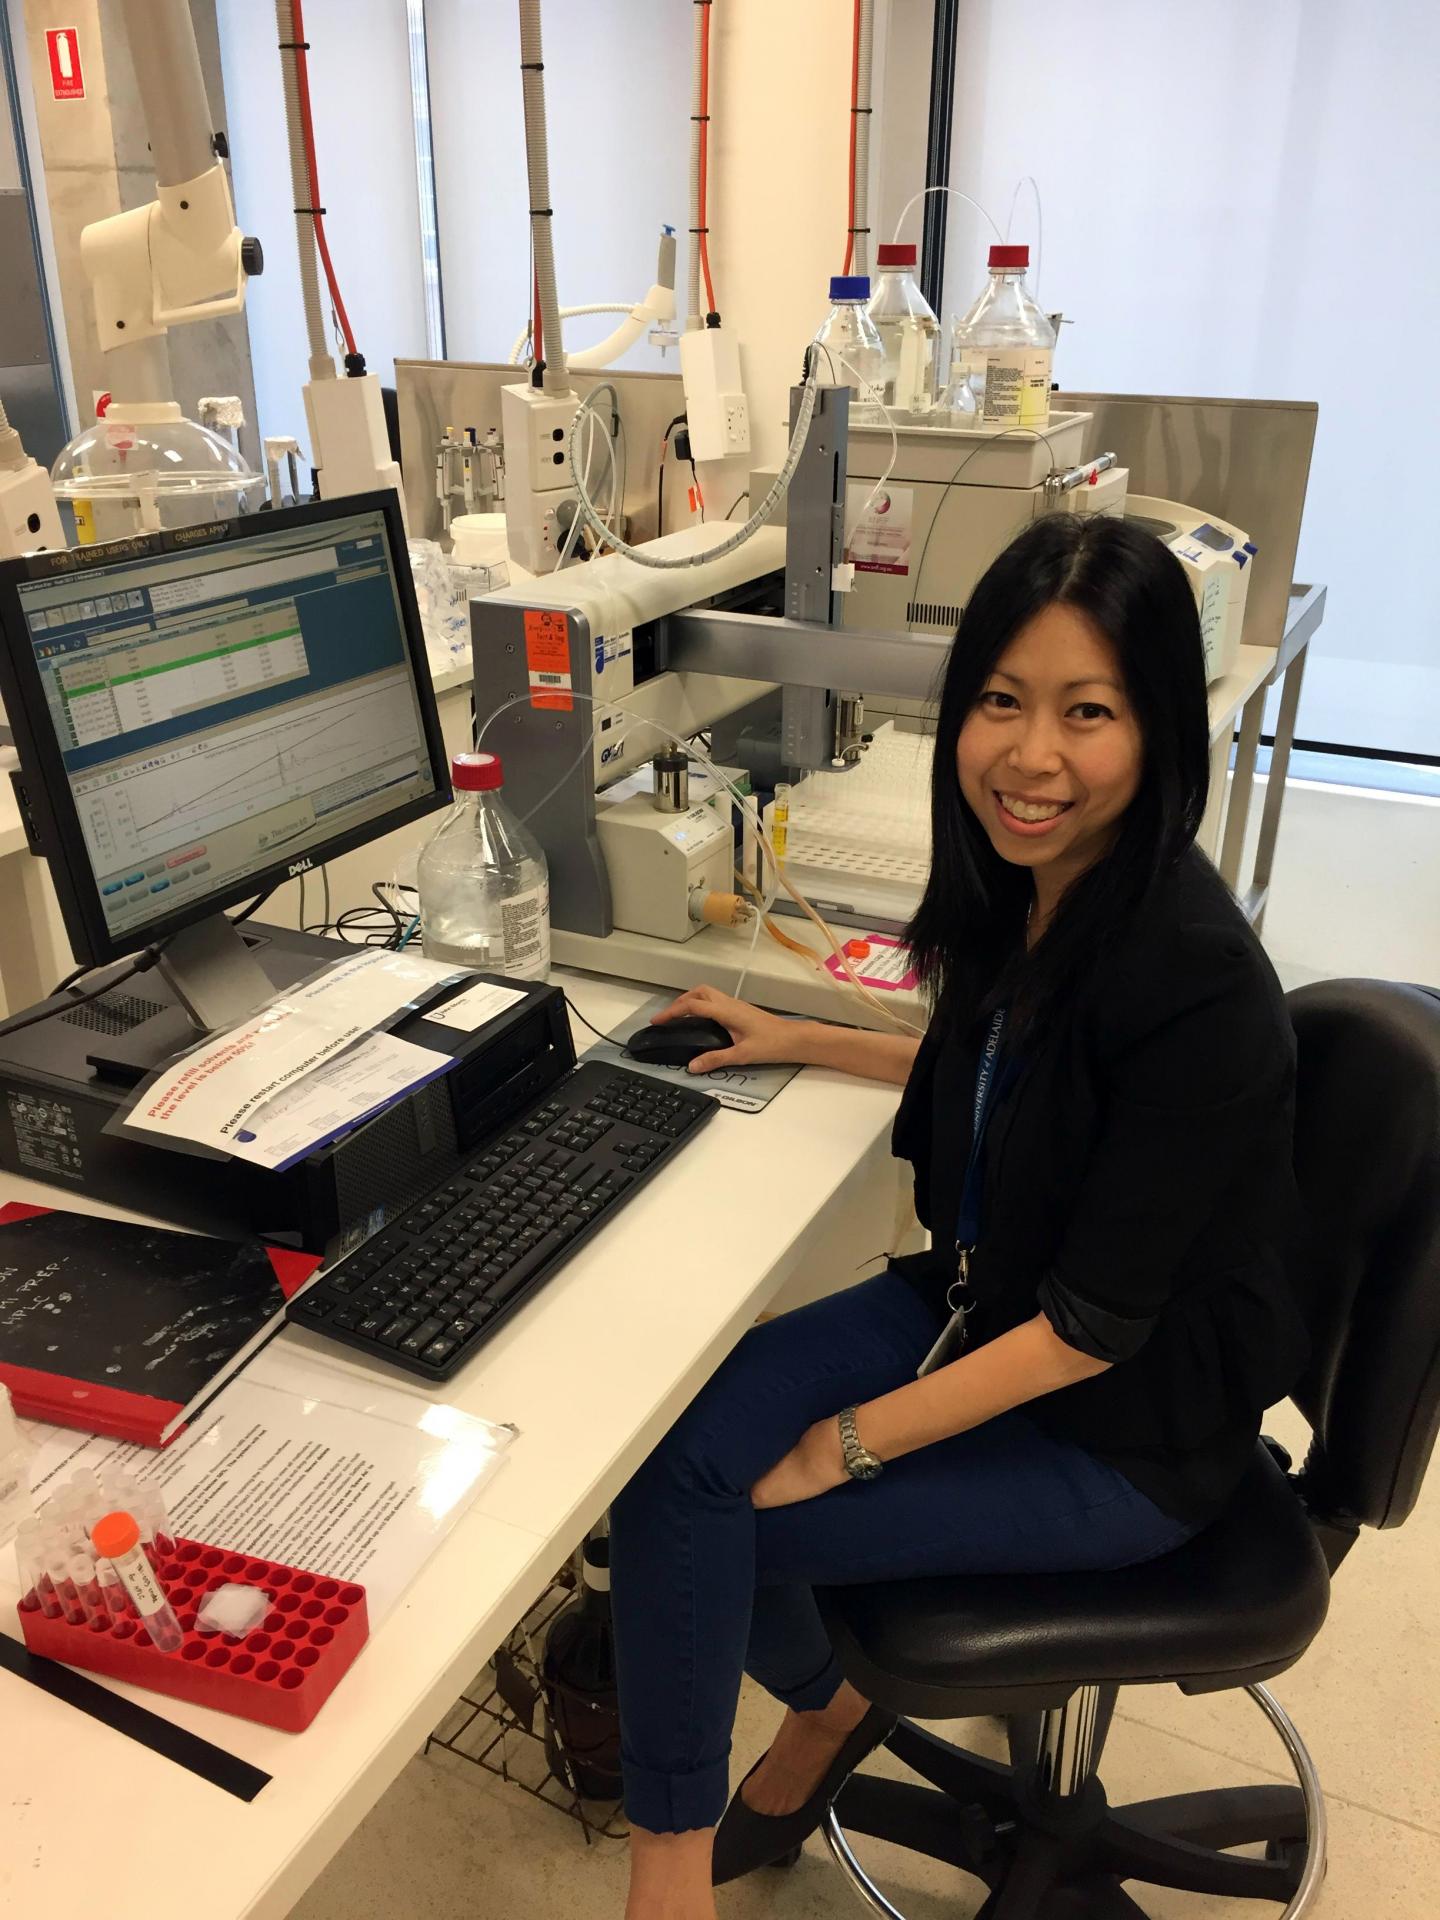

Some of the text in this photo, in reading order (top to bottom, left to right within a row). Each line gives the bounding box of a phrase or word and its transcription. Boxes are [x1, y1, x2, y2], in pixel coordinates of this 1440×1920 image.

[174, 523, 230, 543] CHARGES APPLY
[51, 540, 151, 567] FOR TRAINED USERS ONLY
[289, 858, 314, 876] DELL
[148, 1086, 178, 1117] Please
[178, 1067, 199, 1085] refill
[198, 1043, 237, 1068] solvents
[160, 1103, 177, 1120] the
[176, 1080, 199, 1102] level
[197, 1074, 207, 1083] is
[206, 1055, 234, 1075] below
[220, 1103, 251, 1134] Please
[249, 1080, 281, 1103] restart
[279, 1055, 319, 1083] computer
[317, 1037, 346, 1057] before
[202, 1478, 218, 1491] below
[235, 1444, 253, 1459] system
[304, 1460, 319, 1473] Never
[316, 1447, 330, 1460] delete
[191, 1504, 204, 1514] lack
[327, 1497, 345, 1514] Always
[342, 1489, 352, 1497] use
[295, 1555, 307, 1565] and
[304, 1544, 317, 1555] only
[313, 1534, 325, 1544] tick
[321, 1526, 332, 1535] the
[336, 1507, 349, 1518] next
[351, 1491, 364, 1502] your
[360, 1536, 373, 1548] Start
